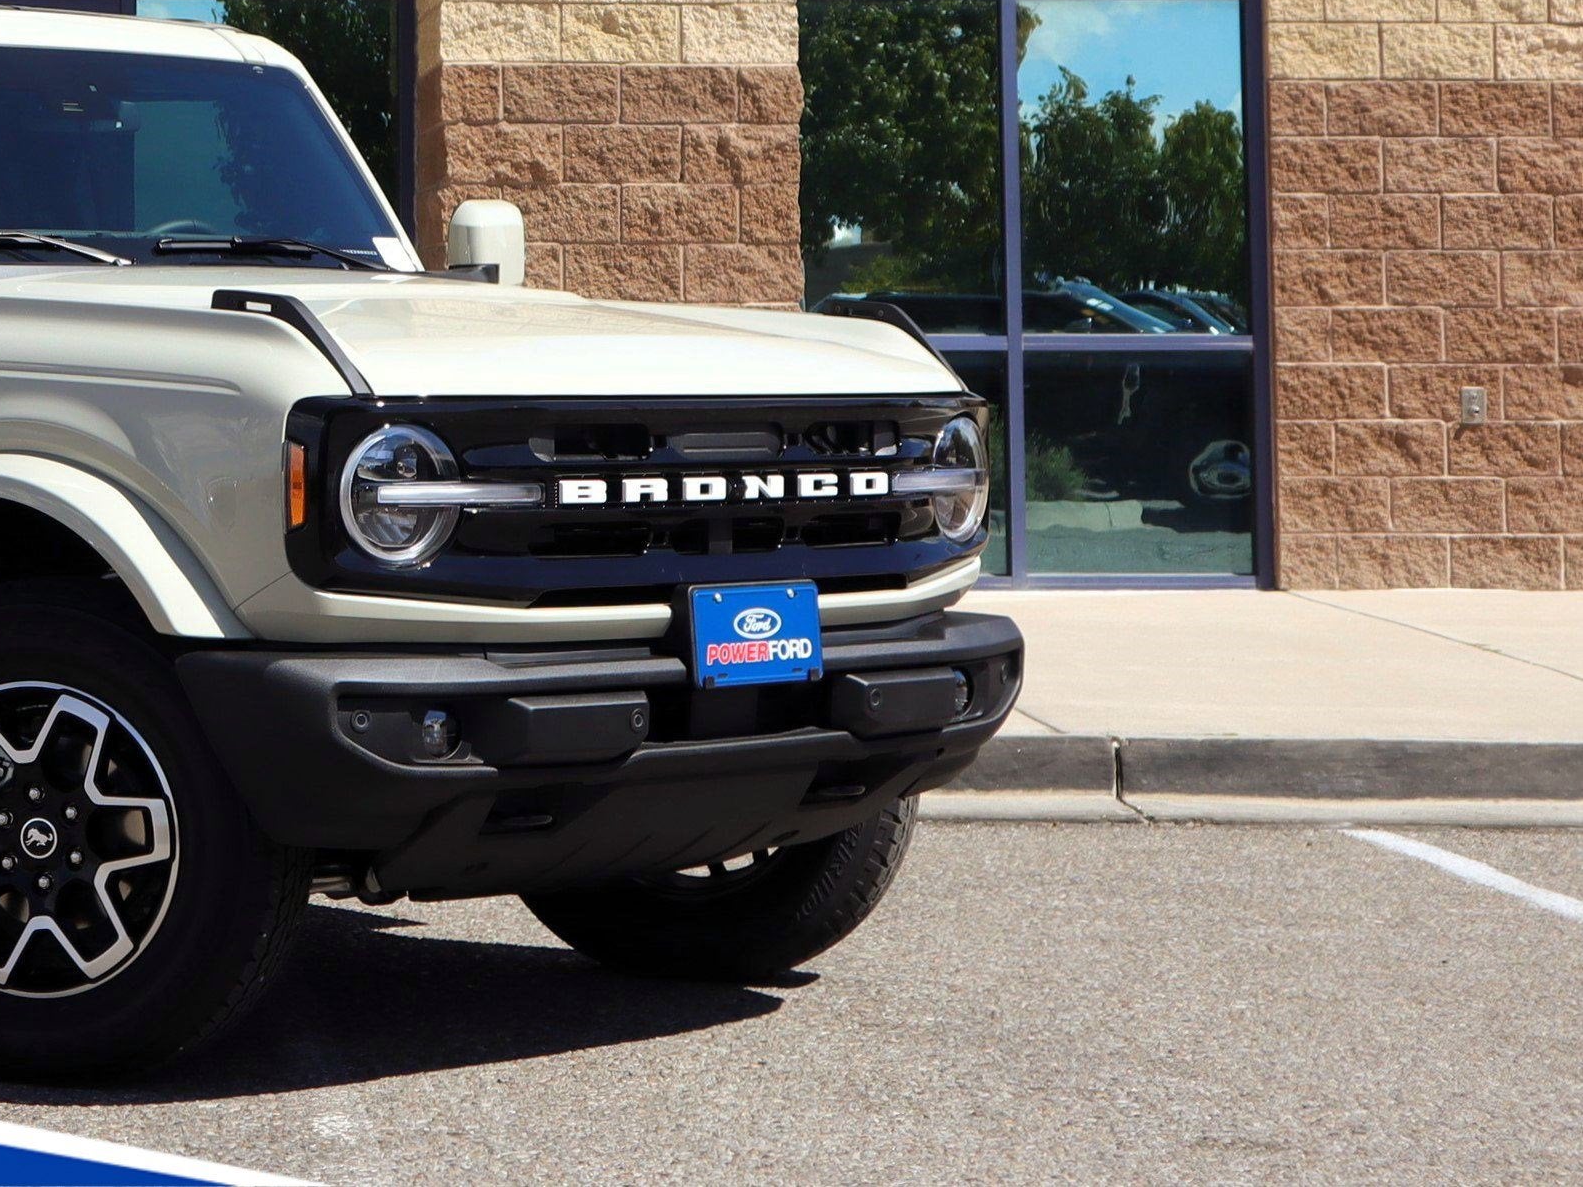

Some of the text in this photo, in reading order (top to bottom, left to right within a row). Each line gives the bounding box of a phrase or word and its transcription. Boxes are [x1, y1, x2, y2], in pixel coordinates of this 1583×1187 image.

[558, 471, 889, 505] BRONCO
[742, 613, 772, 633] Ford
[706, 638, 813, 666] POWERFORD
